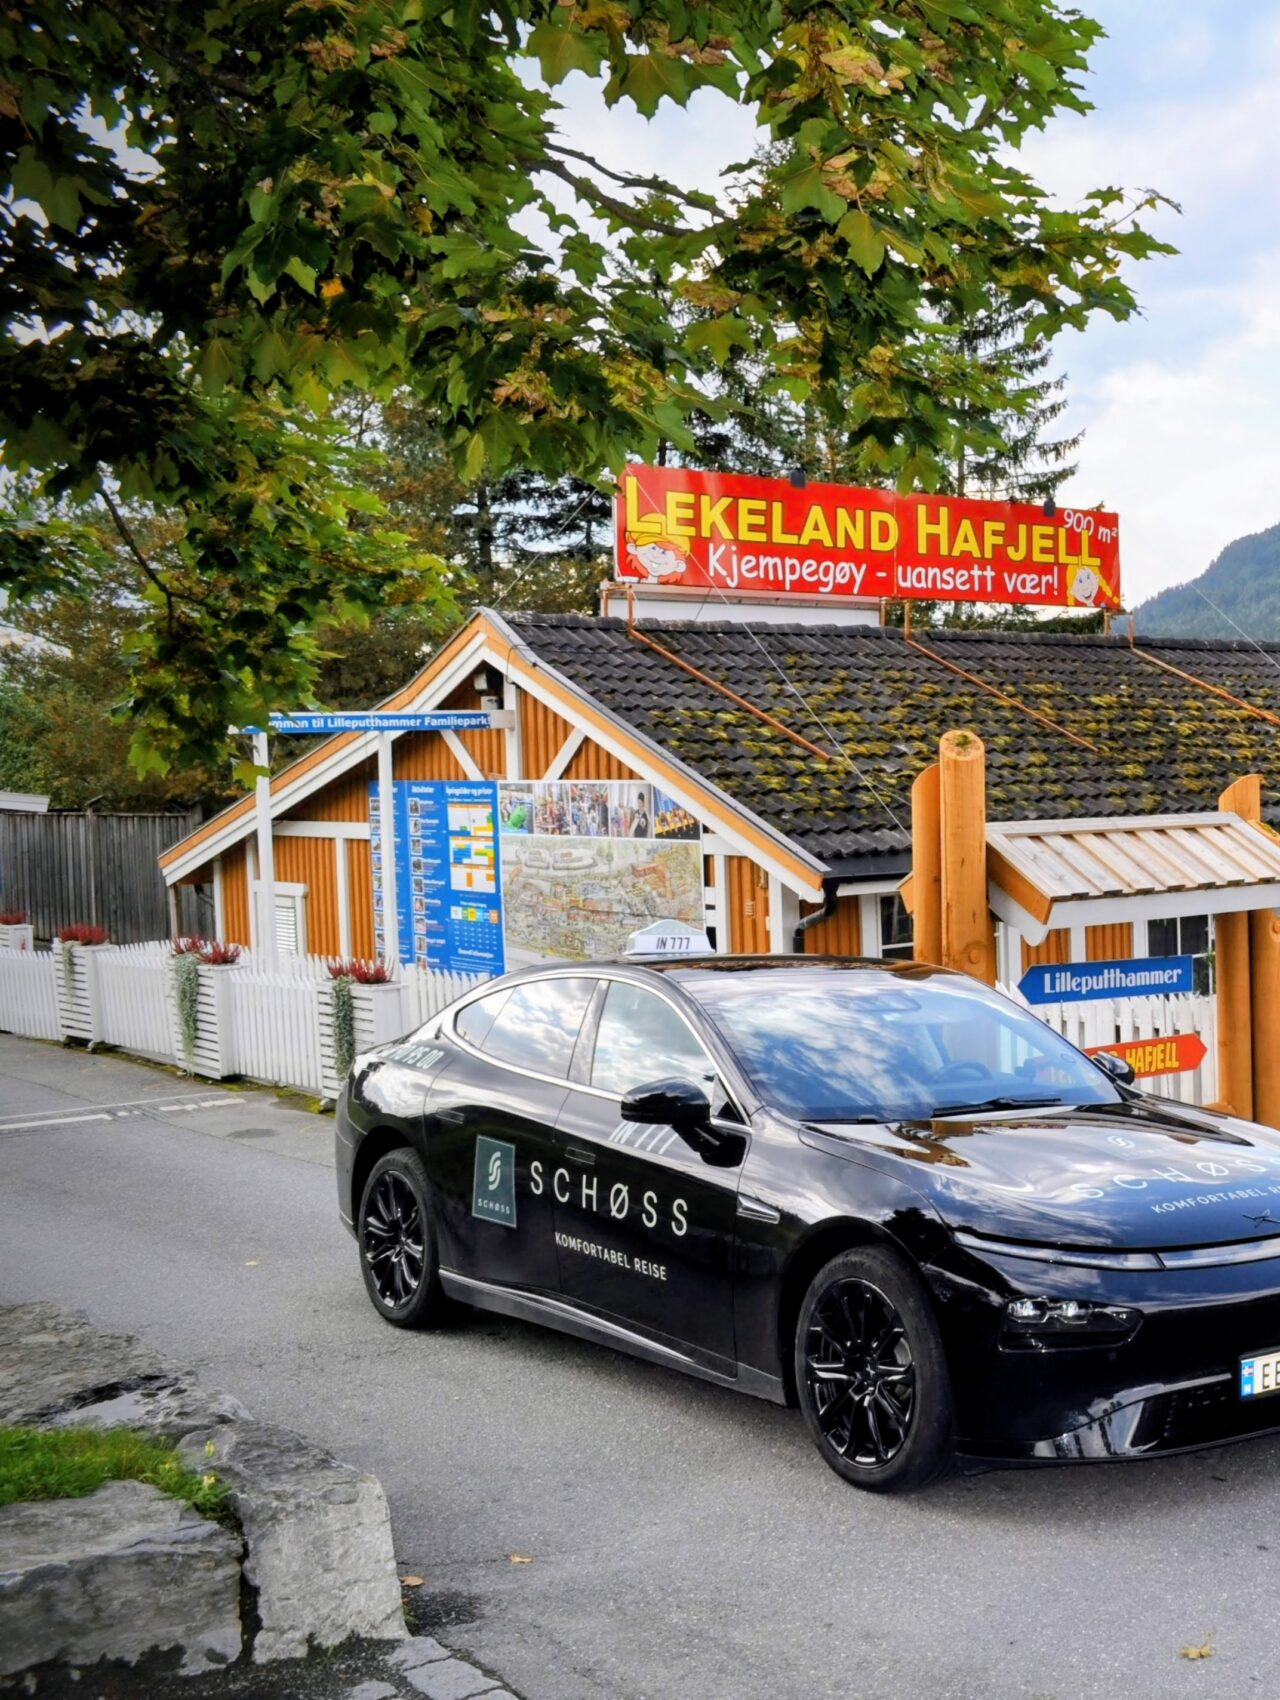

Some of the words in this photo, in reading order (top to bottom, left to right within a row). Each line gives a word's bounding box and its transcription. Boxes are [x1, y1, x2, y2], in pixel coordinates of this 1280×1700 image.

[625, 475, 899, 552] LEKELAND
[917, 504, 1101, 566] HAFJELL
[1063, 509, 1095, 535] 900
[708, 544, 866, 593] Kjempegøy
[898, 564, 994, 589] uansett
[1004, 567, 1059, 597] vær!
[312, 718, 324, 728] til
[327, 716, 422, 731] Lilleputthammer
[656, 936, 668, 950] IN
[670, 936, 691, 950] 777
[1044, 968, 1182, 994] Lilleputthammer
[1125, 1042, 1180, 1073] HAFJELL
[530, 1161, 688, 1237] SCHØSS
[1151, 1187, 1268, 1214] KOMFORTABEL
[554, 1231, 630, 1269] KOMFORTABEL
[634, 1257, 668, 1281] REISE
